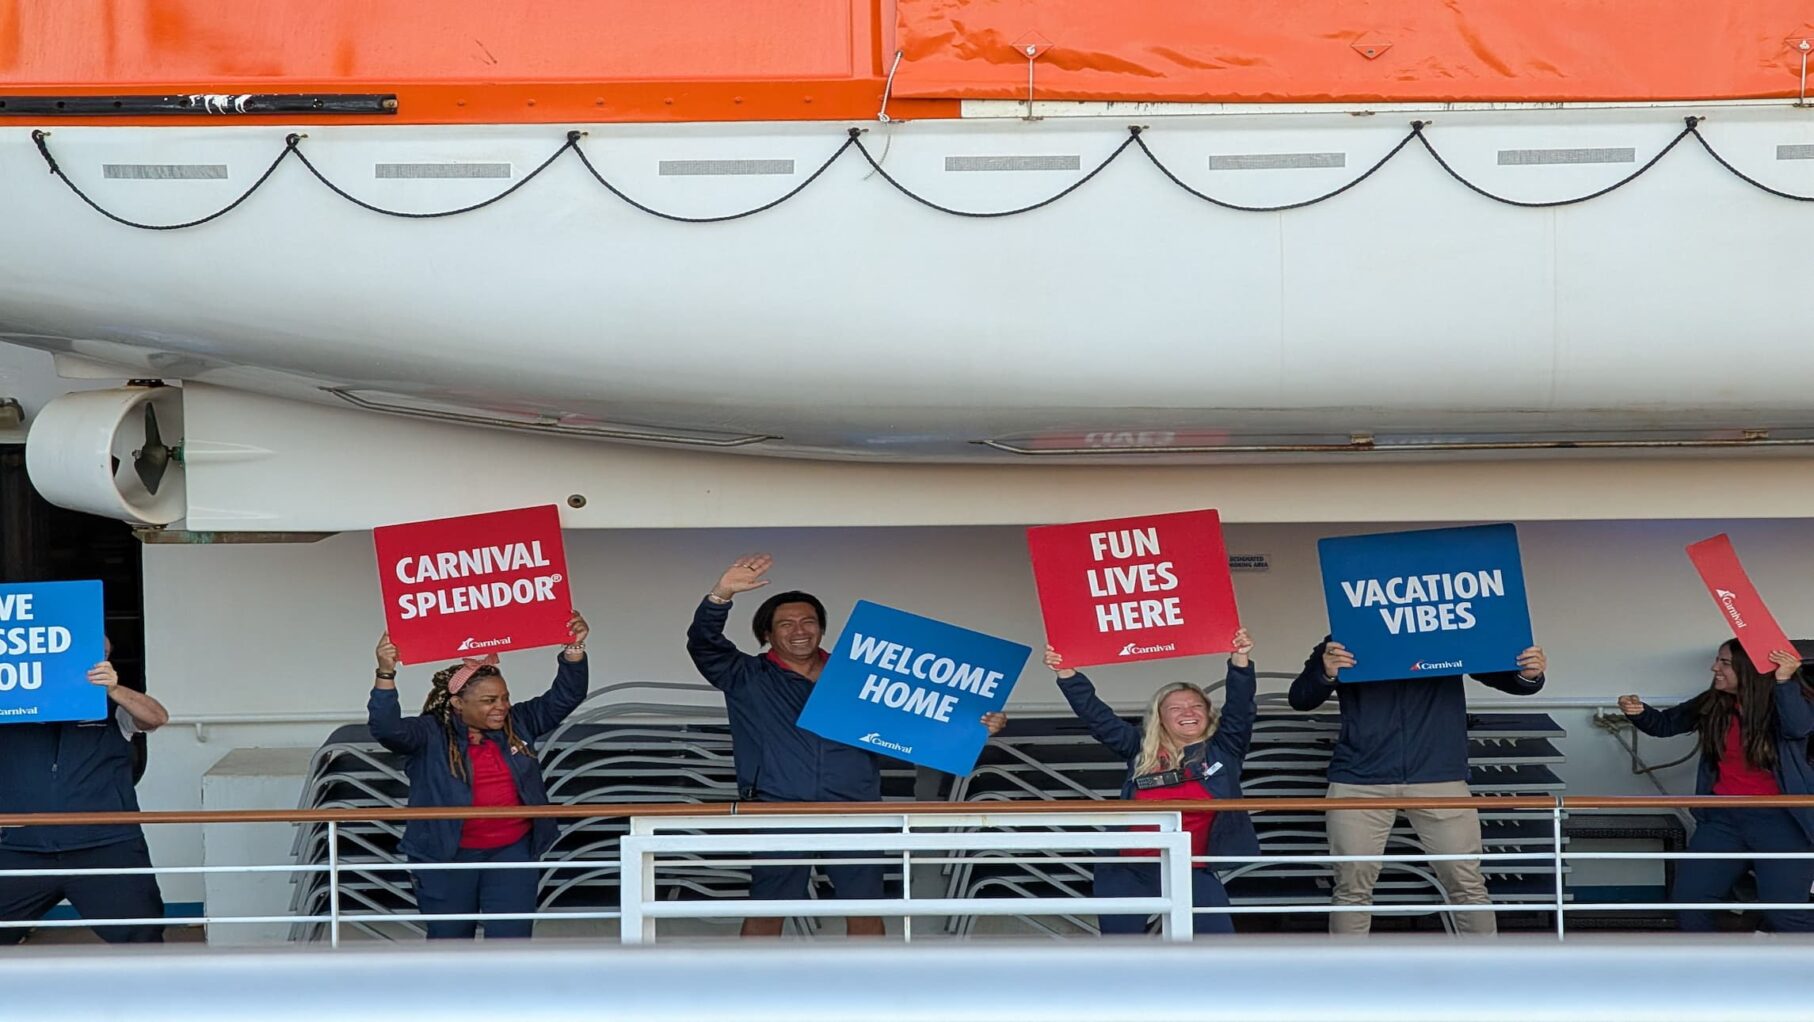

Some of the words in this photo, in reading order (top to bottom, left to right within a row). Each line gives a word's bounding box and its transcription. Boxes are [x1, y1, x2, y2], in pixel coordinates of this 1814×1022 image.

[1090, 527, 1161, 561] FUN
[396, 540, 550, 584] CARNIVAL
[1086, 561, 1179, 598] LIVES
[1341, 569, 1505, 608] VACATION
[1095, 597, 1184, 633] HERE
[1379, 602, 1477, 635] VIBES
[1722, 597, 1747, 628] Carnival
[470, 636, 512, 649] Carnival
[1131, 643, 1176, 655] Carnival
[849, 632, 1005, 699] WELCOME
[1421, 660, 1463, 670] Carnival
[858, 674, 959, 723] HOME
[871, 735, 913, 755] Carnival
